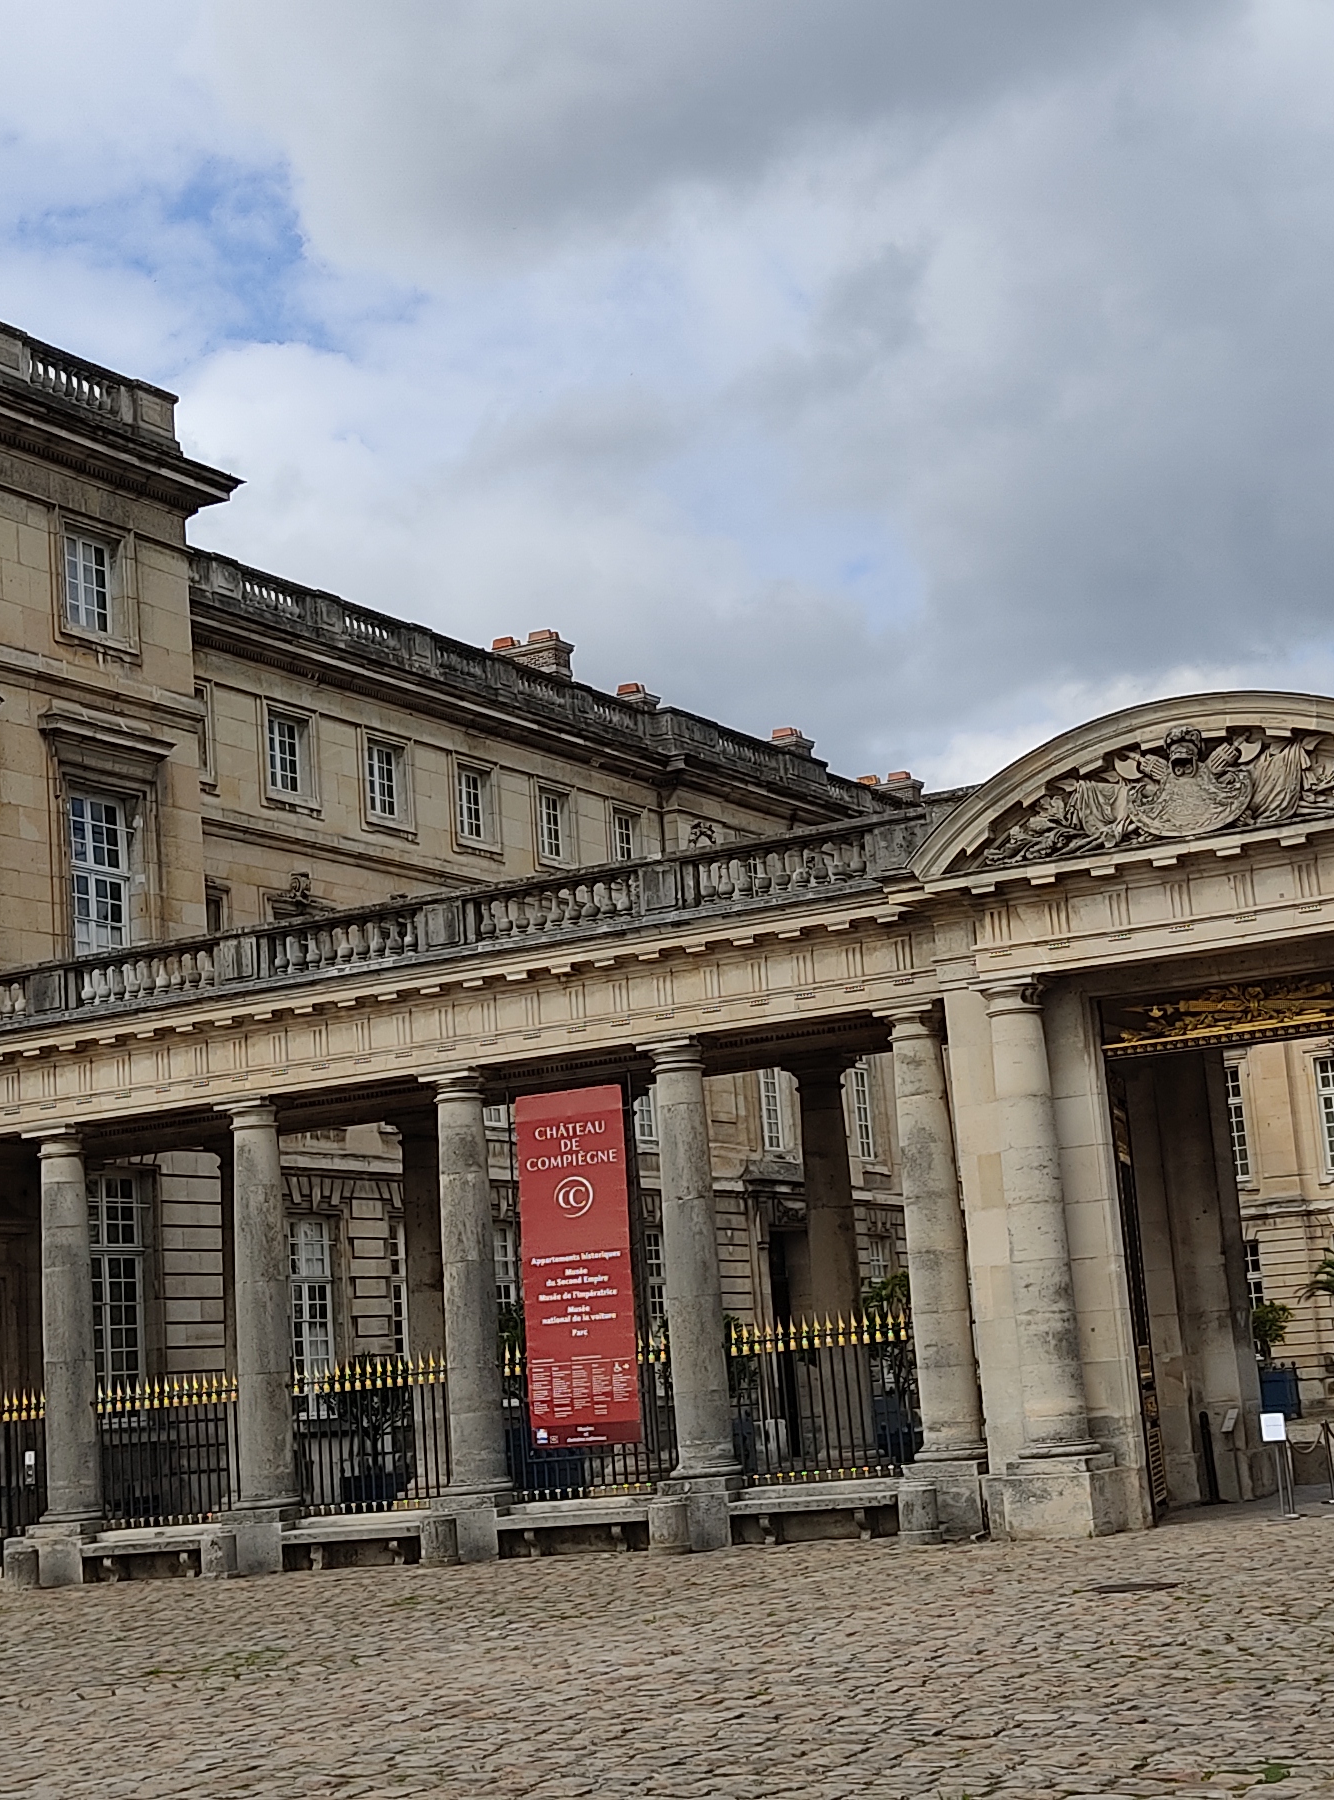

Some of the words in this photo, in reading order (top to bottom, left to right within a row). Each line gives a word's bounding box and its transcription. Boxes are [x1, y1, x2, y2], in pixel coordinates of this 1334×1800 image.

[534, 1120, 606, 1141] CHÂTEAU
[560, 1138, 581, 1153] DE
[526, 1148, 618, 1172] COMPIÈGNE
[530, 1254, 580, 1266] Appartements
[581, 1250, 621, 1260] historiques
[564, 1267, 588, 1276] Musée
[545, 1279, 556, 1288] du
[556, 1276, 582, 1286] Second
[583, 1275, 609, 1286] Empire
[538, 1293, 561, 1302] Musée
[567, 1305, 591, 1314] Musée
[541, 1315, 571, 1325] national
[571, 1314, 582, 1322] de
[582, 1313, 590, 1321] la
[590, 1312, 617, 1321] voiture
[571, 1328, 588, 1336] Parc
